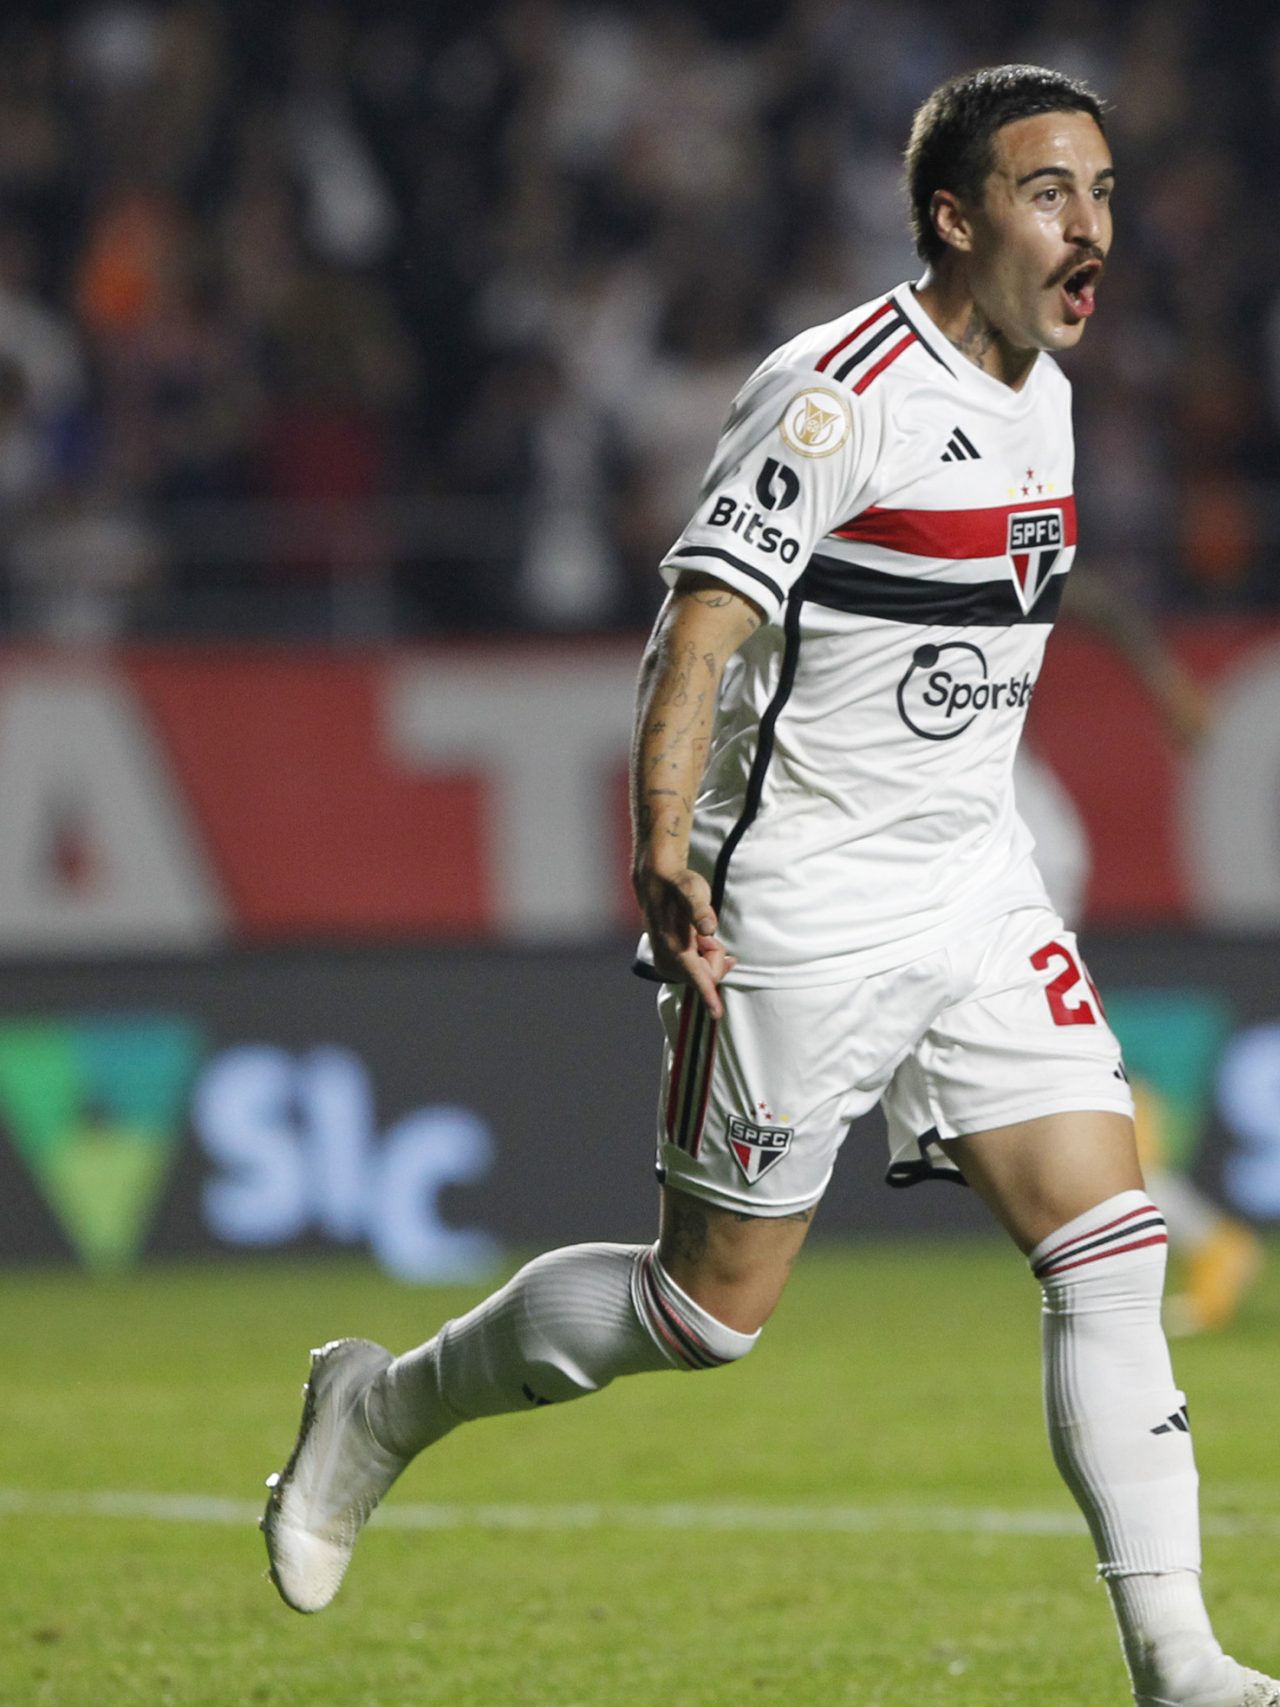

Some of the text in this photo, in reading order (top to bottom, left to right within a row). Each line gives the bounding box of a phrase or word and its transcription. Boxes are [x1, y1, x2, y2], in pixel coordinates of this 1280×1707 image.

[707, 496, 800, 564] Bitso
[1012, 519, 1060, 545] SPFC
[1030, 940, 1107, 1026] 2
[733, 1123, 786, 1146] SPFC
